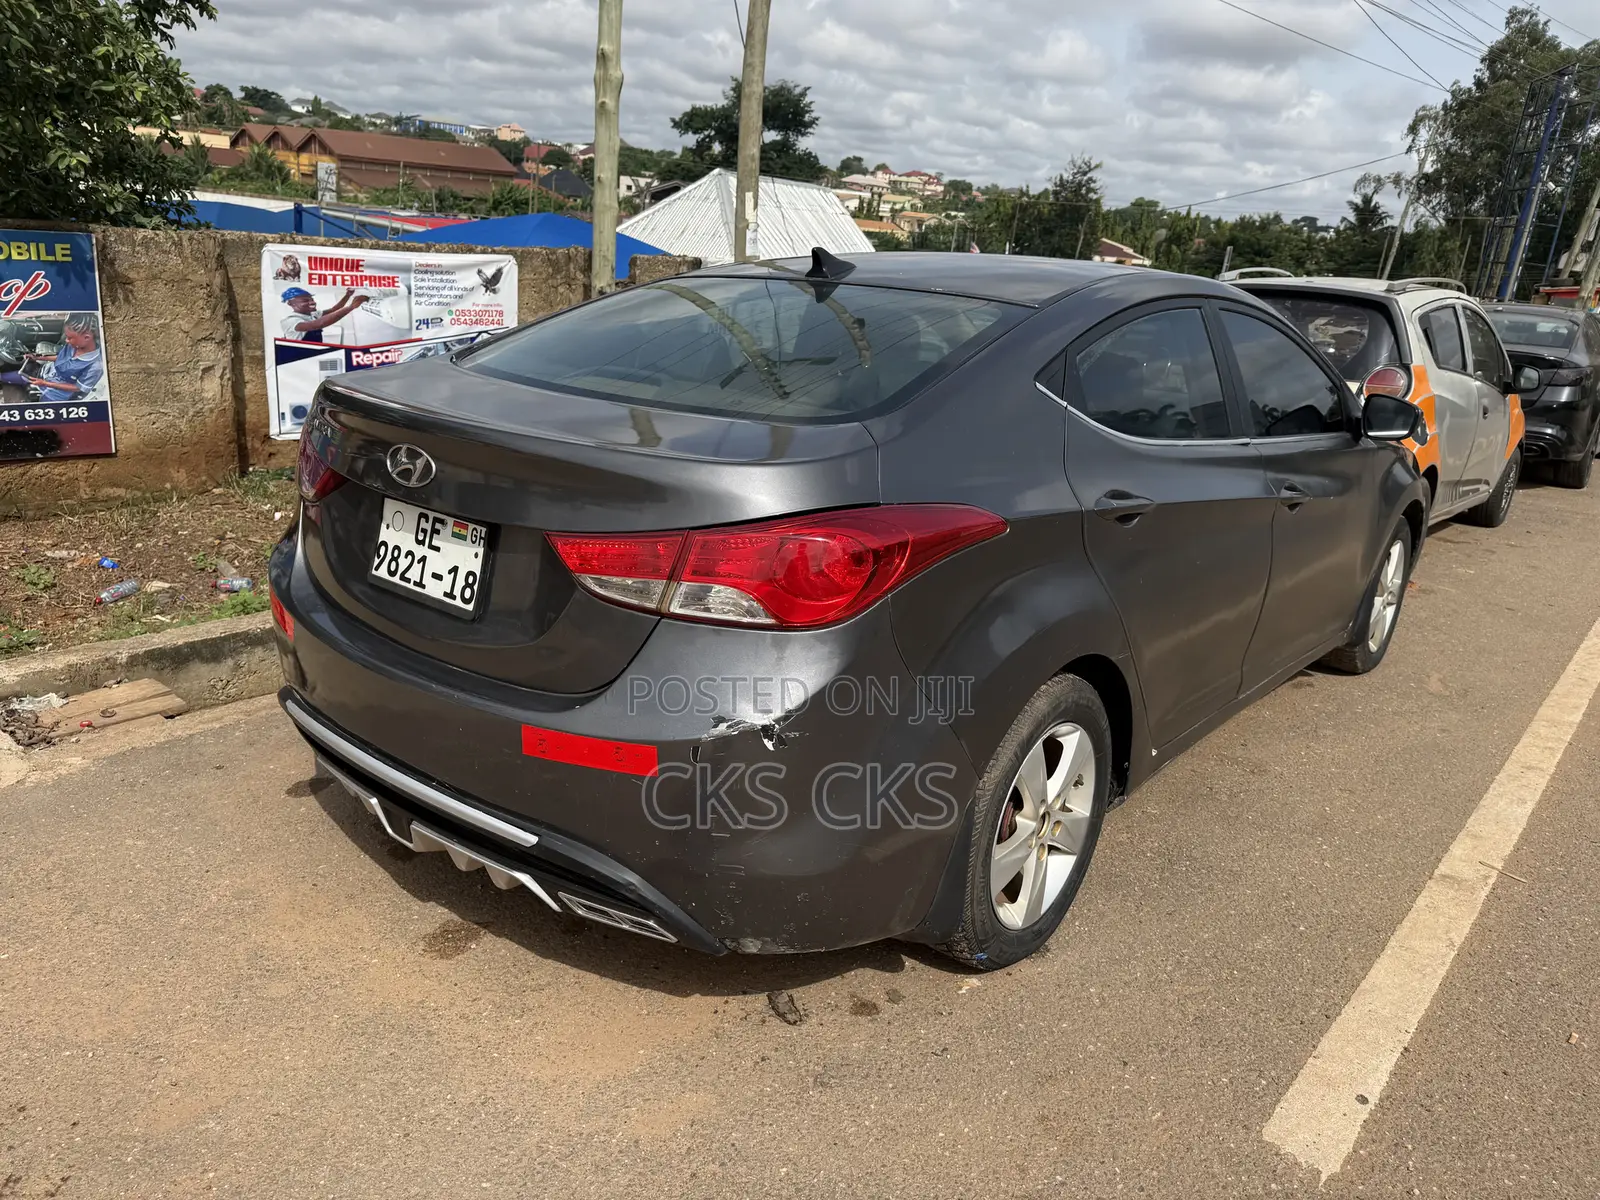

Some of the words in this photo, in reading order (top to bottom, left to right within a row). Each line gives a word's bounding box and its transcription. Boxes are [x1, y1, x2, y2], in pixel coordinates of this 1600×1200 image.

[308, 256, 365, 272] UNIQUE
[414, 269, 434, 277] Cooling
[308, 273, 400, 288] ENTERPRISE
[414, 284, 440, 292] Servicing
[414, 292, 452, 300] Refrigerators
[455, 309, 503, 317] 0533071178
[415, 318, 430, 330] 24
[351, 349, 403, 368] Repair
[24, 408, 55, 420] 633
[60, 406, 88, 418] 126
[414, 512, 445, 553] GE
[470, 527, 486, 547] GH
[374, 540, 478, 604] 9821-18
